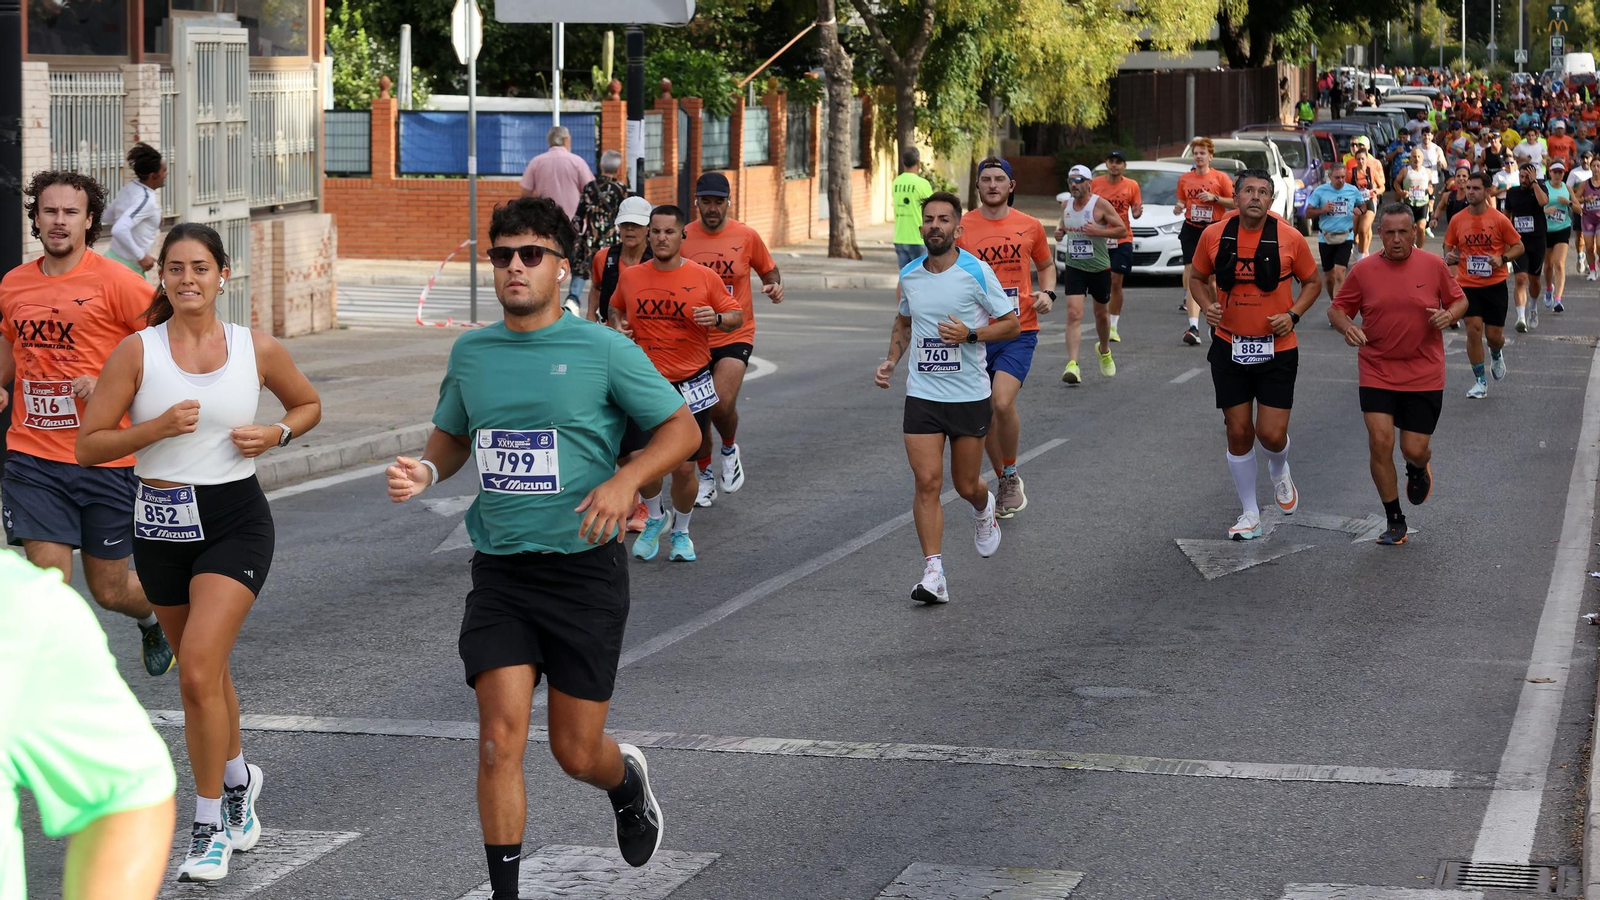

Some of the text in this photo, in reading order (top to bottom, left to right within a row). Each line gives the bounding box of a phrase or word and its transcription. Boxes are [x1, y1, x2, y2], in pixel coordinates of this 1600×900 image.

[895, 184, 915, 193] STAFF
[1464, 234, 1492, 245] XXIX
[977, 244, 1021, 262] XXIX
[1472, 262, 1485, 270] 977
[635, 299, 687, 318] XXIX
[14, 320, 75, 344] XXIX
[924, 350, 949, 361] 760
[1241, 344, 1263, 354] 882
[32, 397, 60, 414] 516
[496, 450, 535, 473] 799
[144, 504, 180, 524] 852
